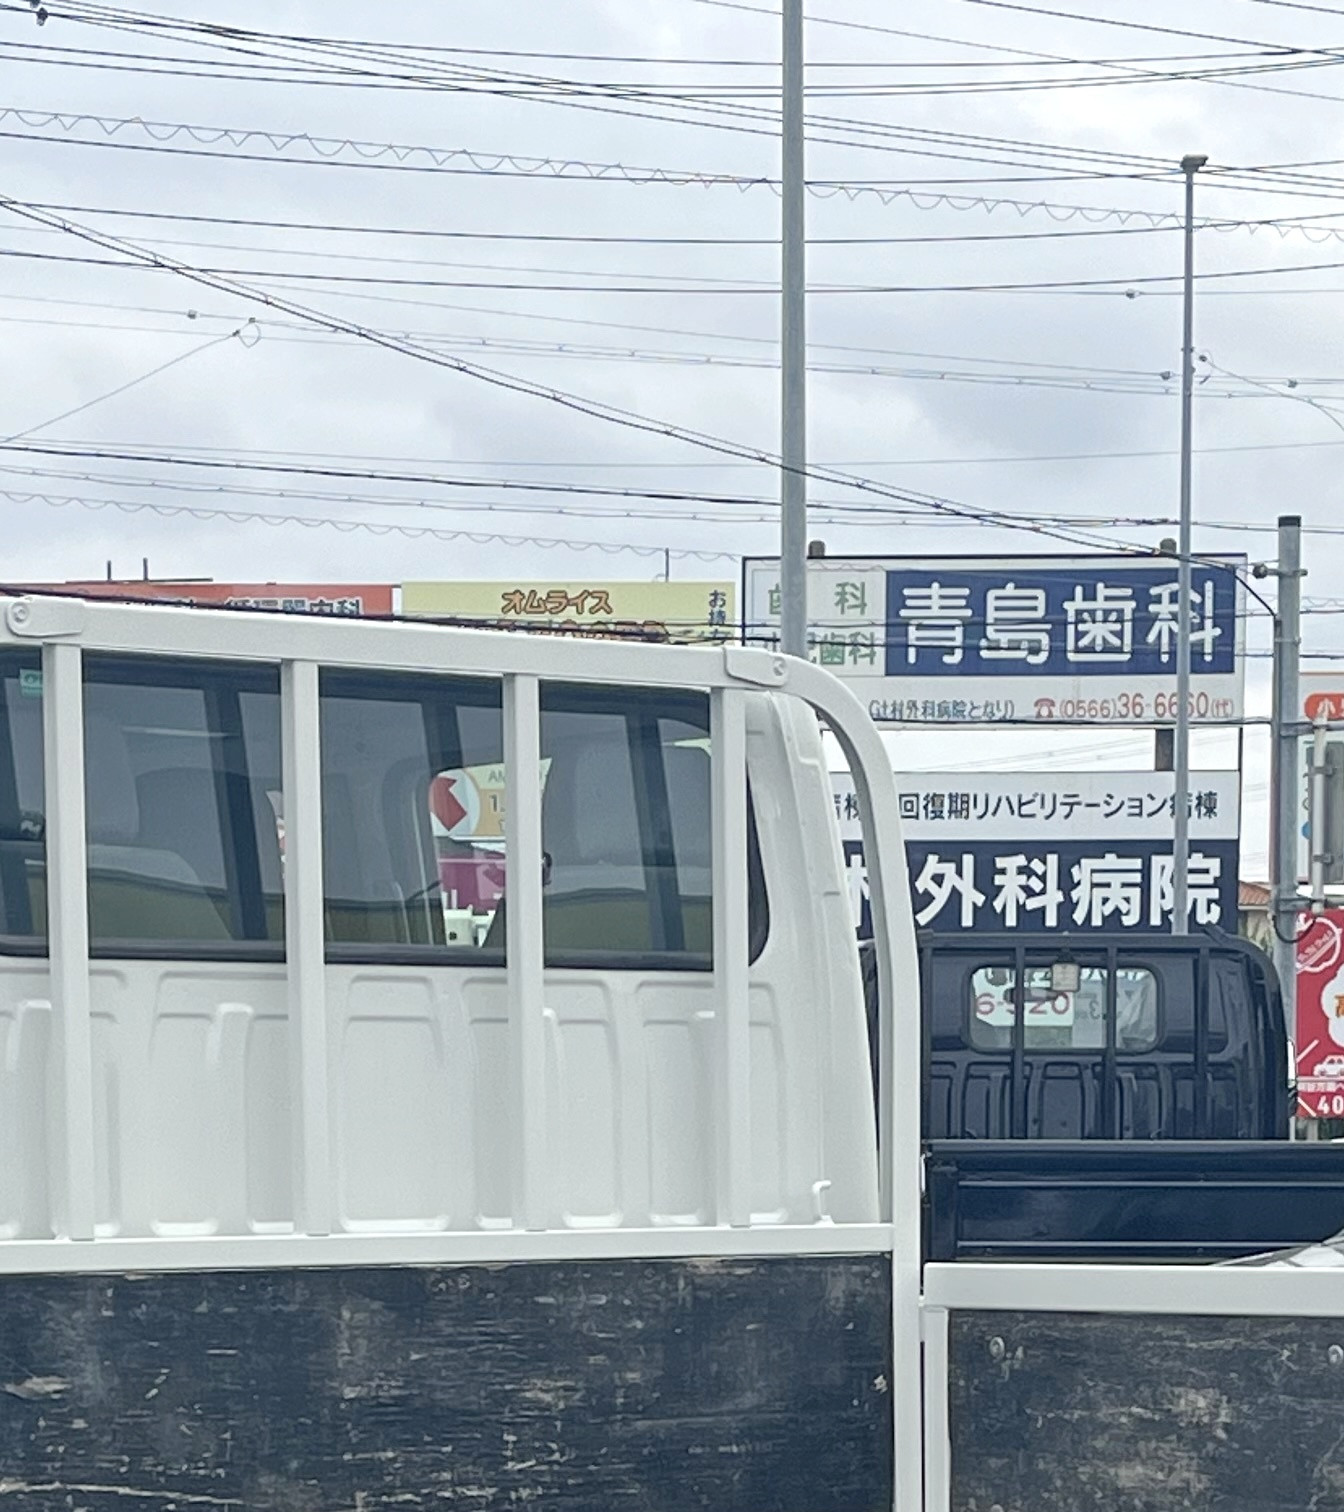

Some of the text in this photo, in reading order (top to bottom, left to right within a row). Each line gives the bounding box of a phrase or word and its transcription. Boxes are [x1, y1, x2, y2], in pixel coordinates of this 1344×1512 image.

[502, 589, 613, 615] オムライス
[899, 580, 1223, 665] 青島歯科
